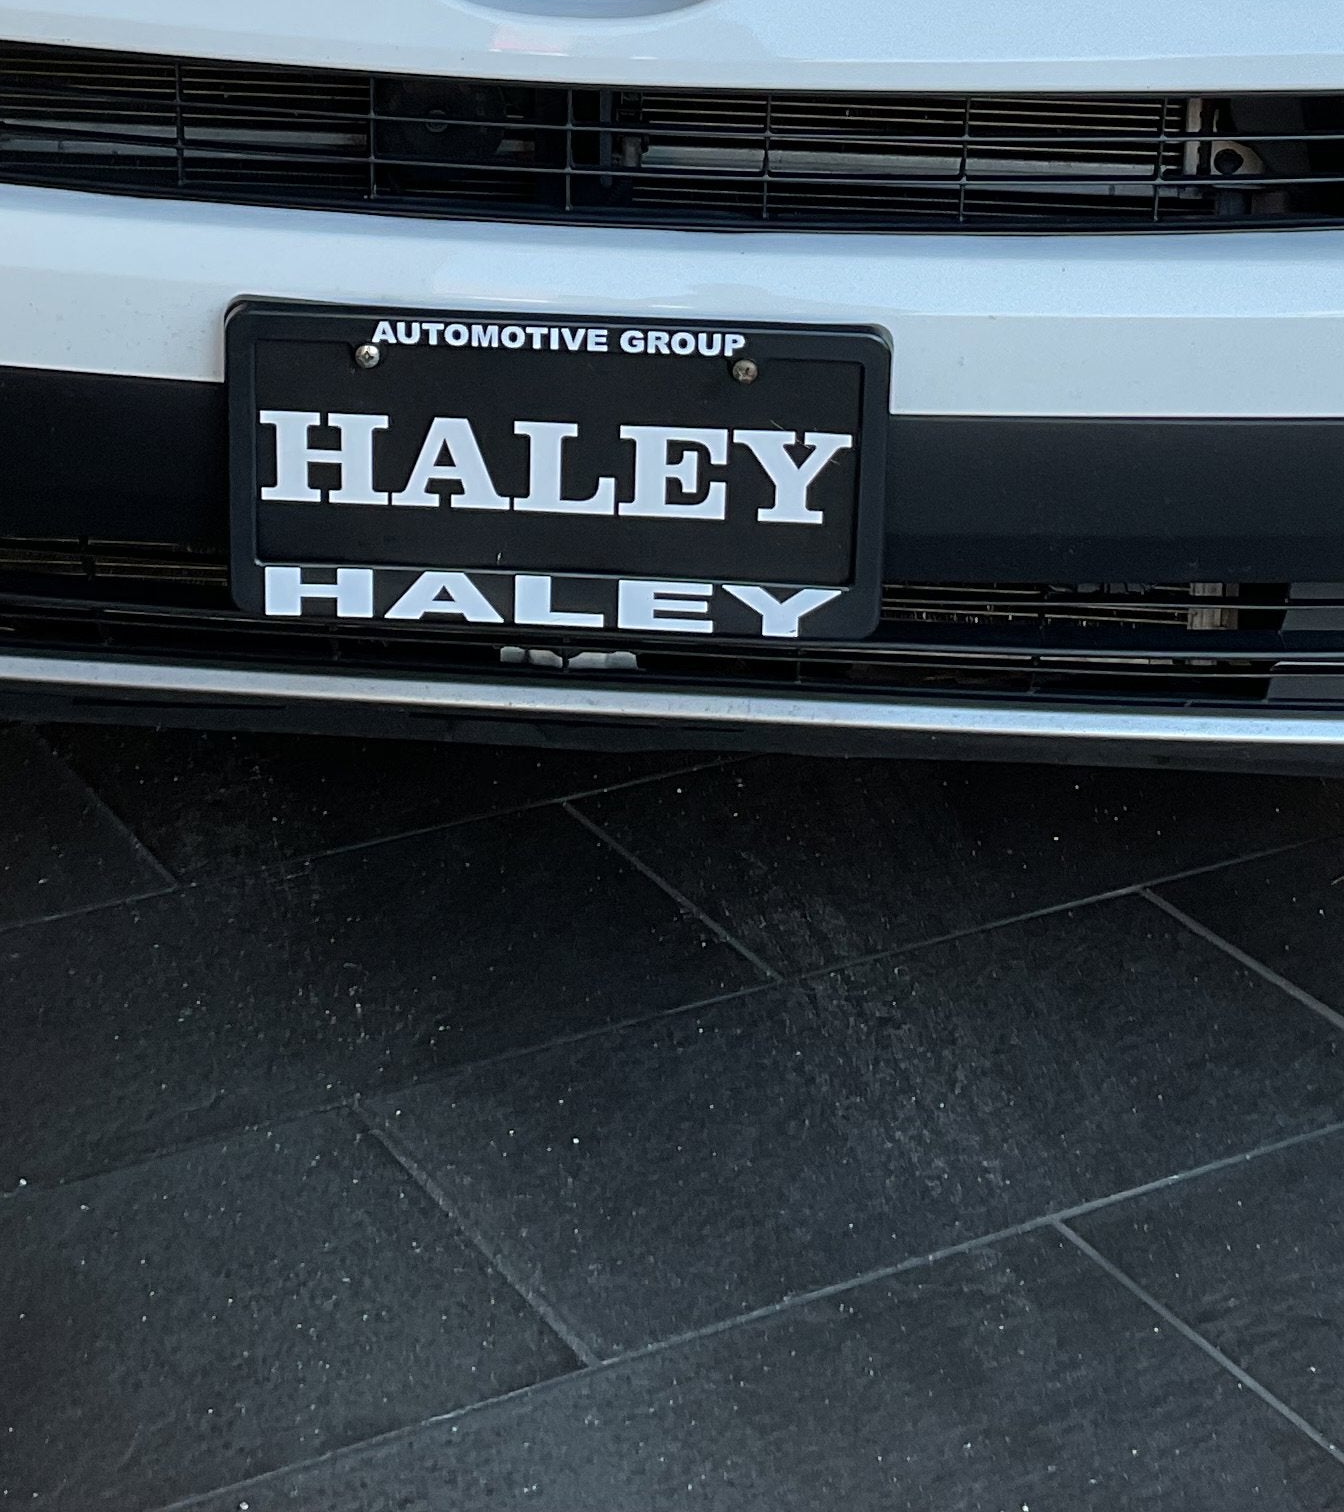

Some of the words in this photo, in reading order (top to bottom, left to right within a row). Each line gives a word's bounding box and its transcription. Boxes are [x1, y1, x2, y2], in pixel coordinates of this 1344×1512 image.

[371, 320, 608, 352] AUTOMOTIVE
[619, 330, 746, 357] GROUP
[259, 410, 853, 525] HALEY
[264, 566, 843, 638] HALEY
